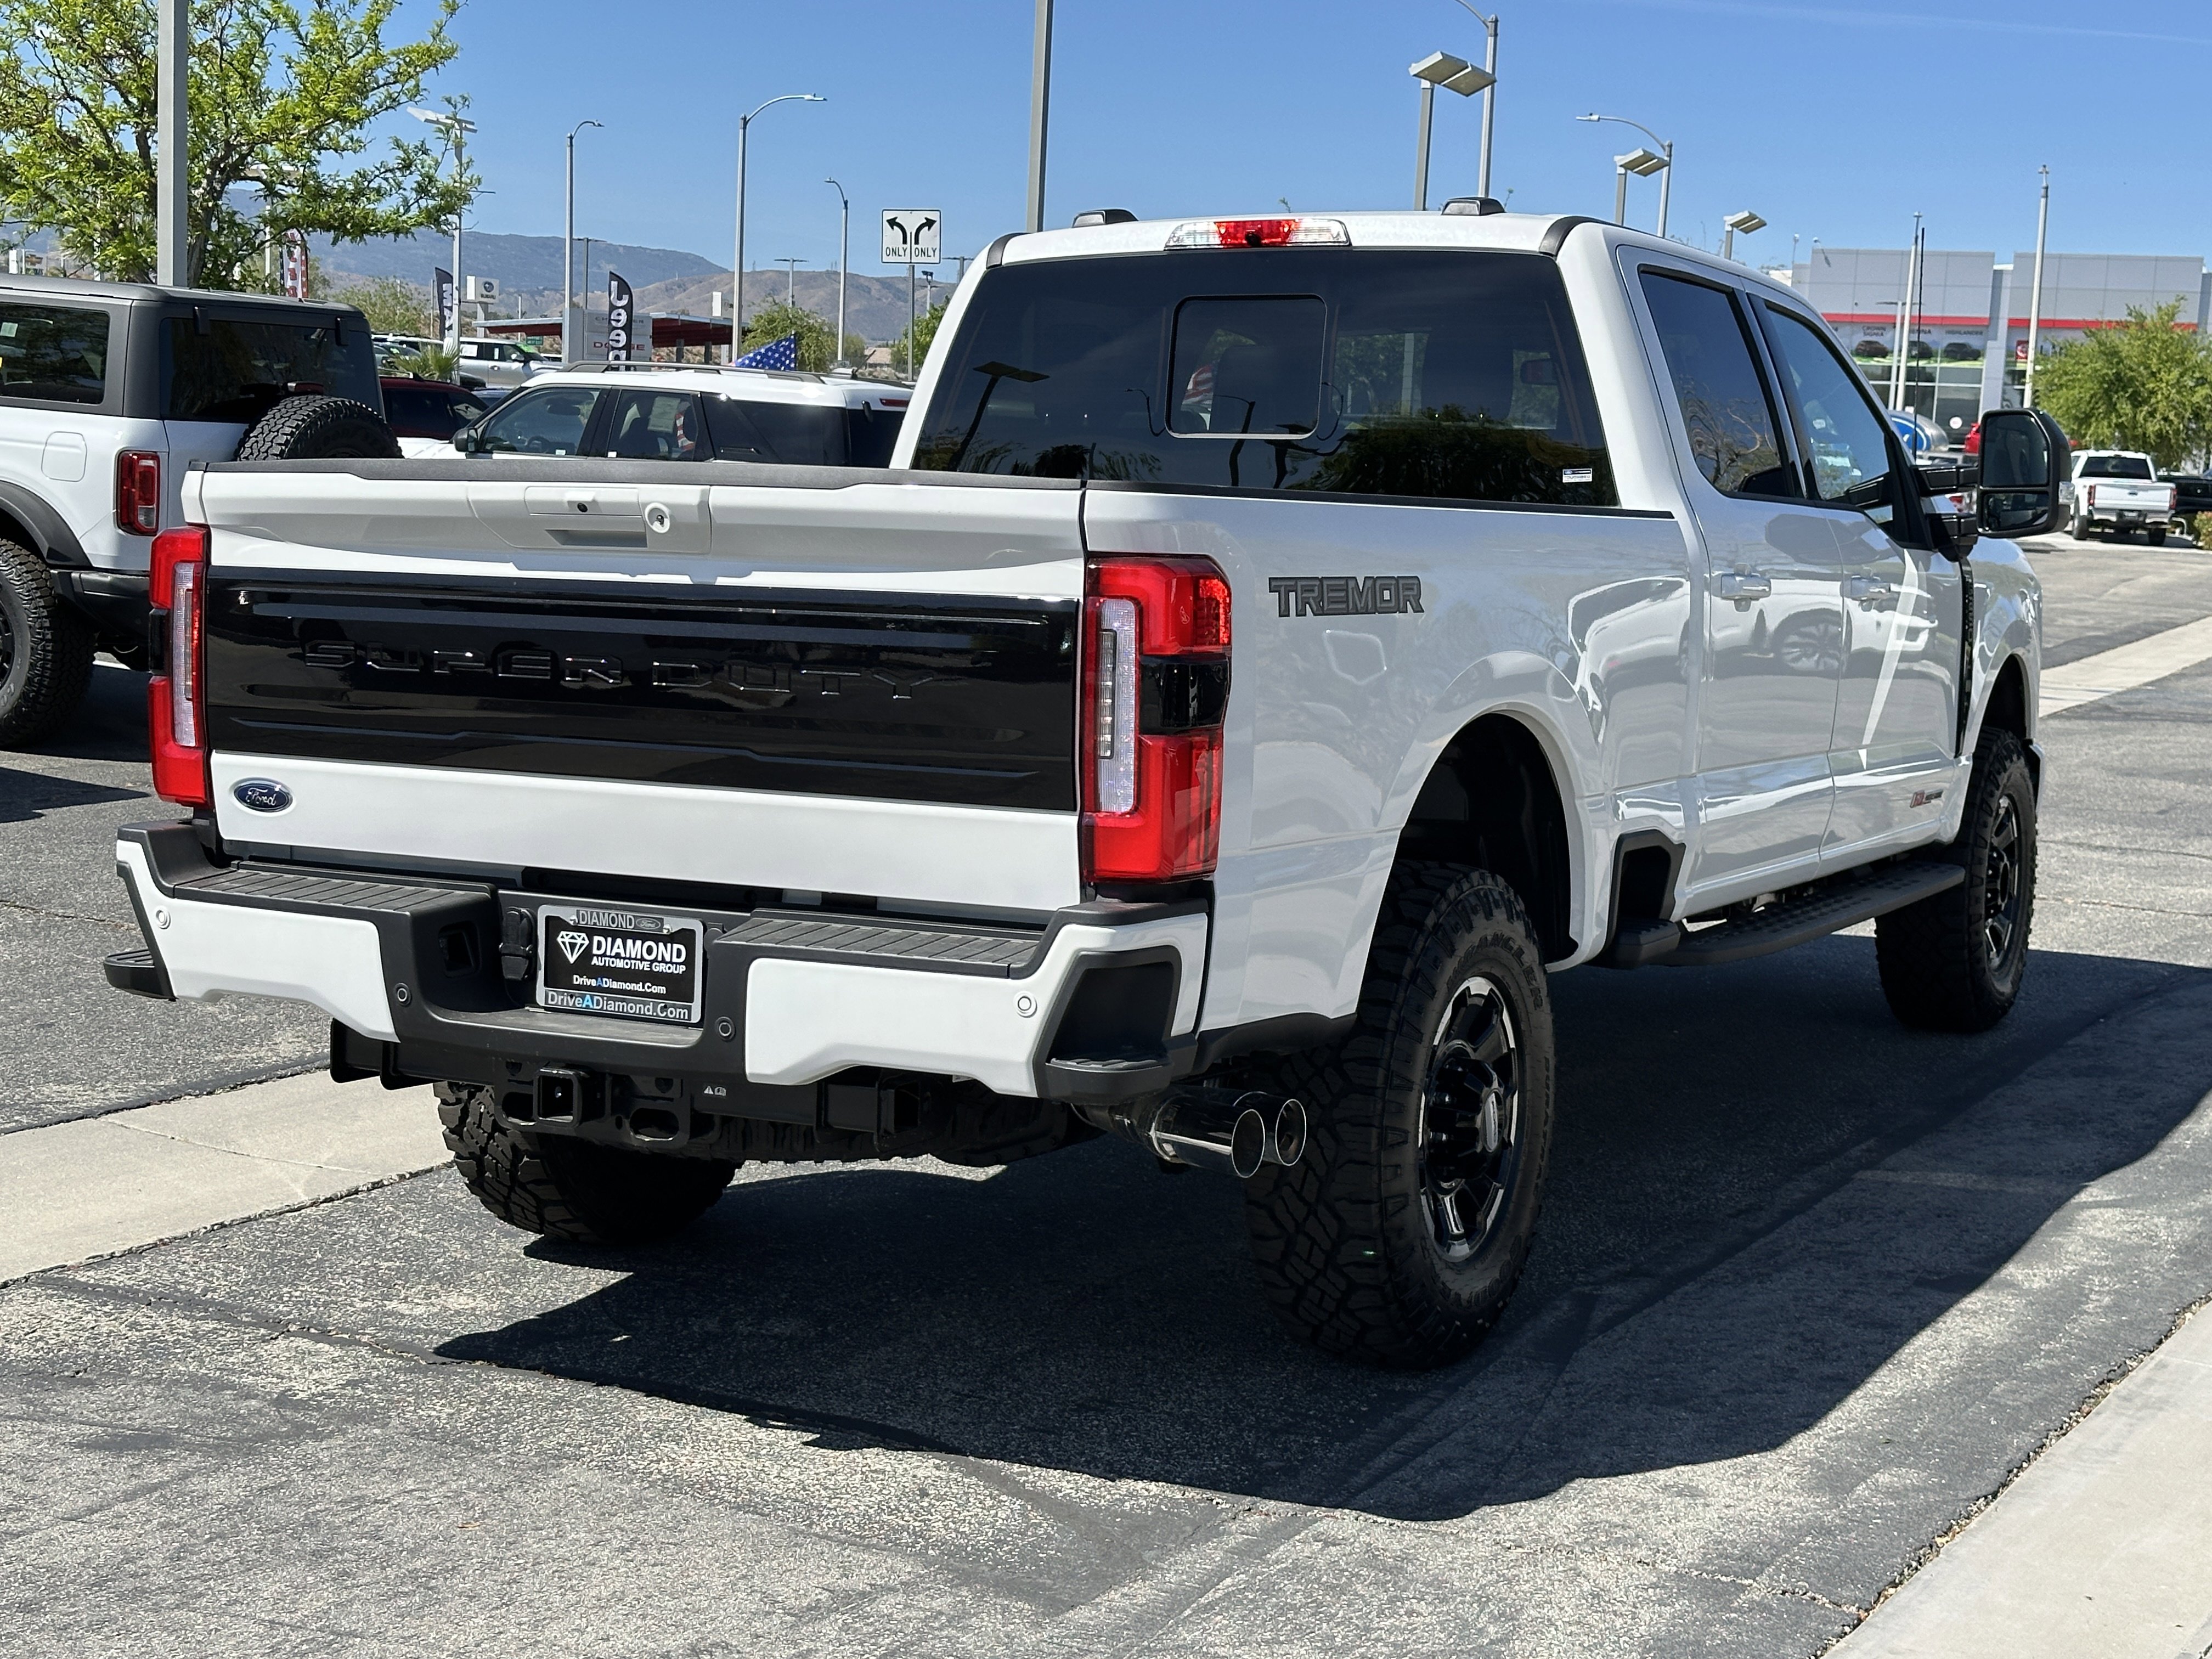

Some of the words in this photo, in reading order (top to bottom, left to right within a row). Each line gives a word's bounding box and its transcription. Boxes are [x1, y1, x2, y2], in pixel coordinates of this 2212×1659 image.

[885, 246, 907, 257] ONLY
[914, 247, 937, 257] ONLY
[1268, 576, 1425, 618] TREMOR
[304, 640, 623, 685] SUPER
[652, 657, 934, 699] DUTY
[245, 787, 277, 806] Ford
[579, 910, 635, 929] DIAMOND
[592, 935, 686, 963] DIAMOND
[591, 956, 651, 971] AUTOMOTIVE
[652, 963, 686, 974] GROUP
[573, 974, 667, 994] DriveADiamond.Com
[548, 991, 689, 1019] DriveADiamond.Com
